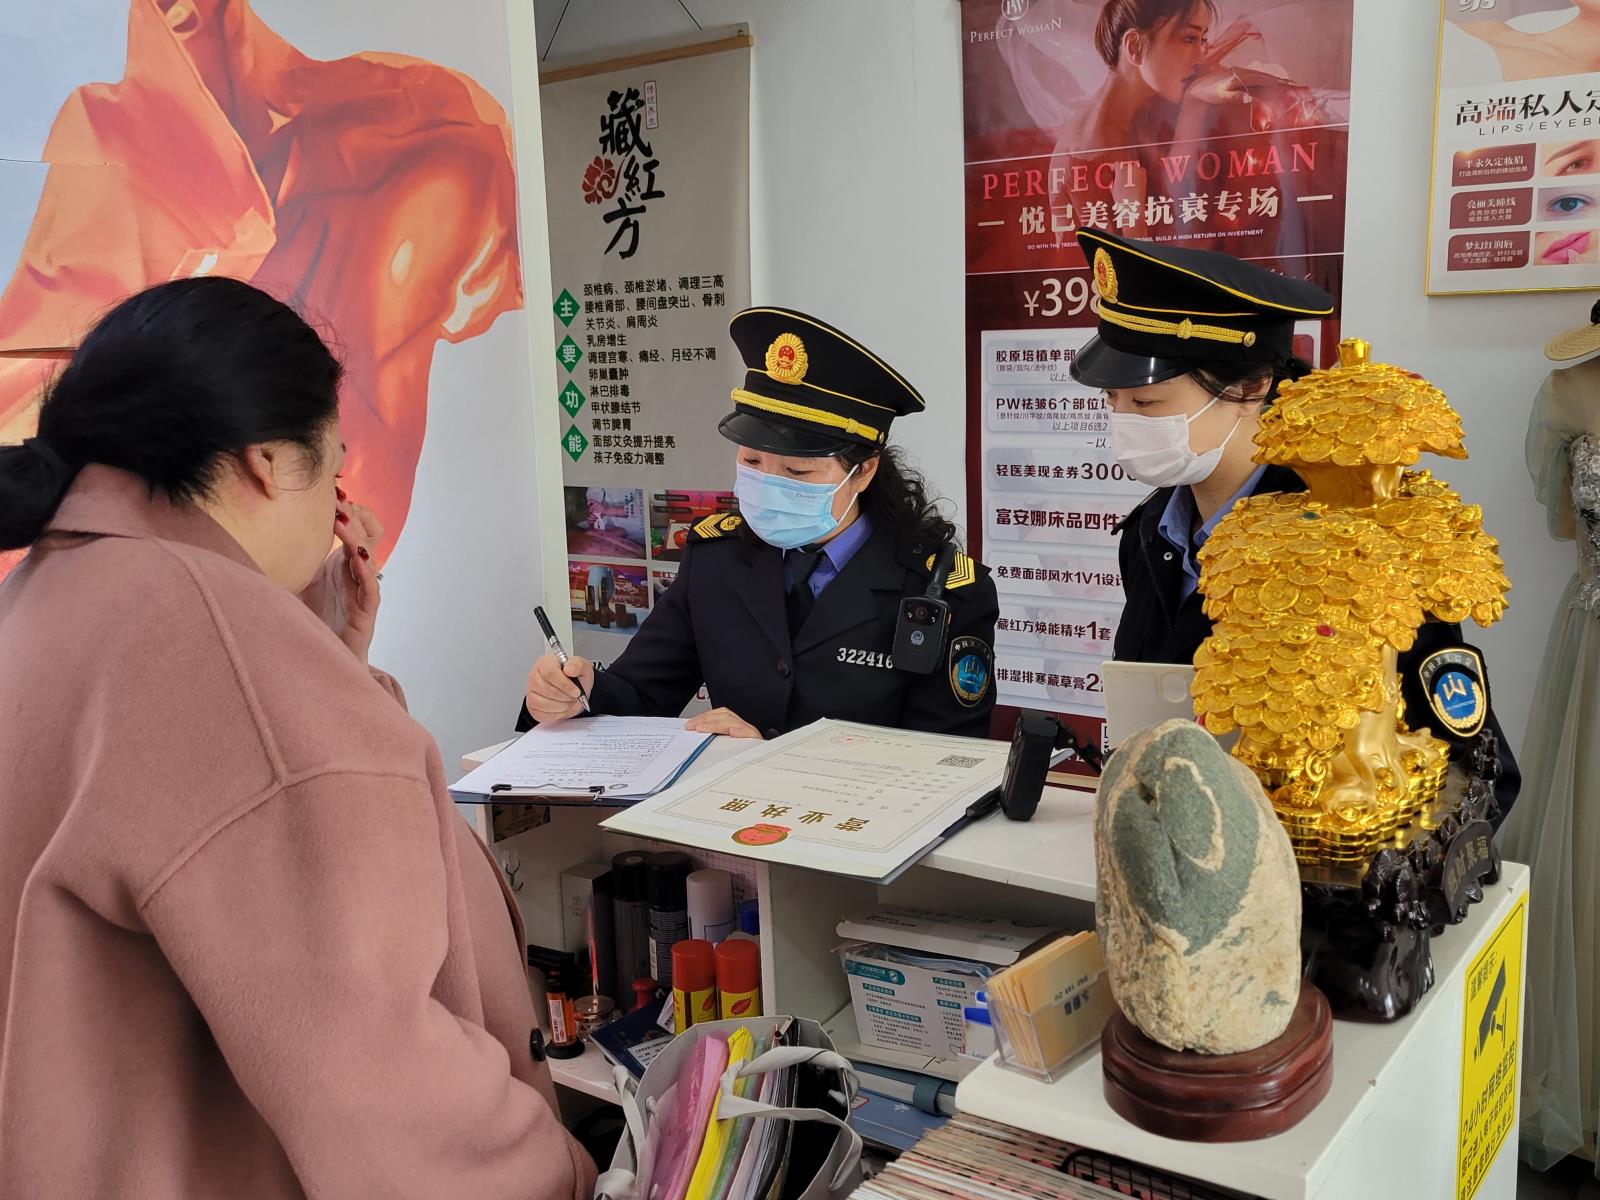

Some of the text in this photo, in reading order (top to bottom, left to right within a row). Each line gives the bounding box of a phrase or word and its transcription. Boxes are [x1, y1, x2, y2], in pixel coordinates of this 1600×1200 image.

[970, 17, 1062, 44] PERFECT WOMAN
[1479, 117, 1600, 136] LIPS/EYEB
[982, 141, 1320, 201] PERFECT WOMAN
[1019, 186, 1279, 237] 悦己美容抗衰专场
[1156, 234, 1172, 242] BUILD
[1194, 231, 1217, 239] RETURN
[1227, 229, 1264, 237] INVESTMENT
[586, 315, 659, 331] 关节炎、肩周炎
[586, 333, 628, 348] 乳房增生
[588, 347, 717, 364] 调理宫寒、痛经、月经不调
[589, 367, 630, 382] 卵巢囊肿
[590, 384, 630, 398] 淋巴排毒
[591, 401, 642, 415] 甲状腺结节
[592, 417, 632, 432] 调节脾胃
[593, 434, 676, 449] 面部艾灸提升提亮
[594, 451, 666, 465] 孩子免疫力调整
[996, 463, 1137, 482] 轻医美现金券300
[996, 508, 1125, 530] 富安娜床品四件
[997, 618, 1112, 641] 藏红方焕能精华1套
[997, 668, 1104, 693] 排湿排寒藏草膏2
[719, 797, 871, 833] 营业执照
